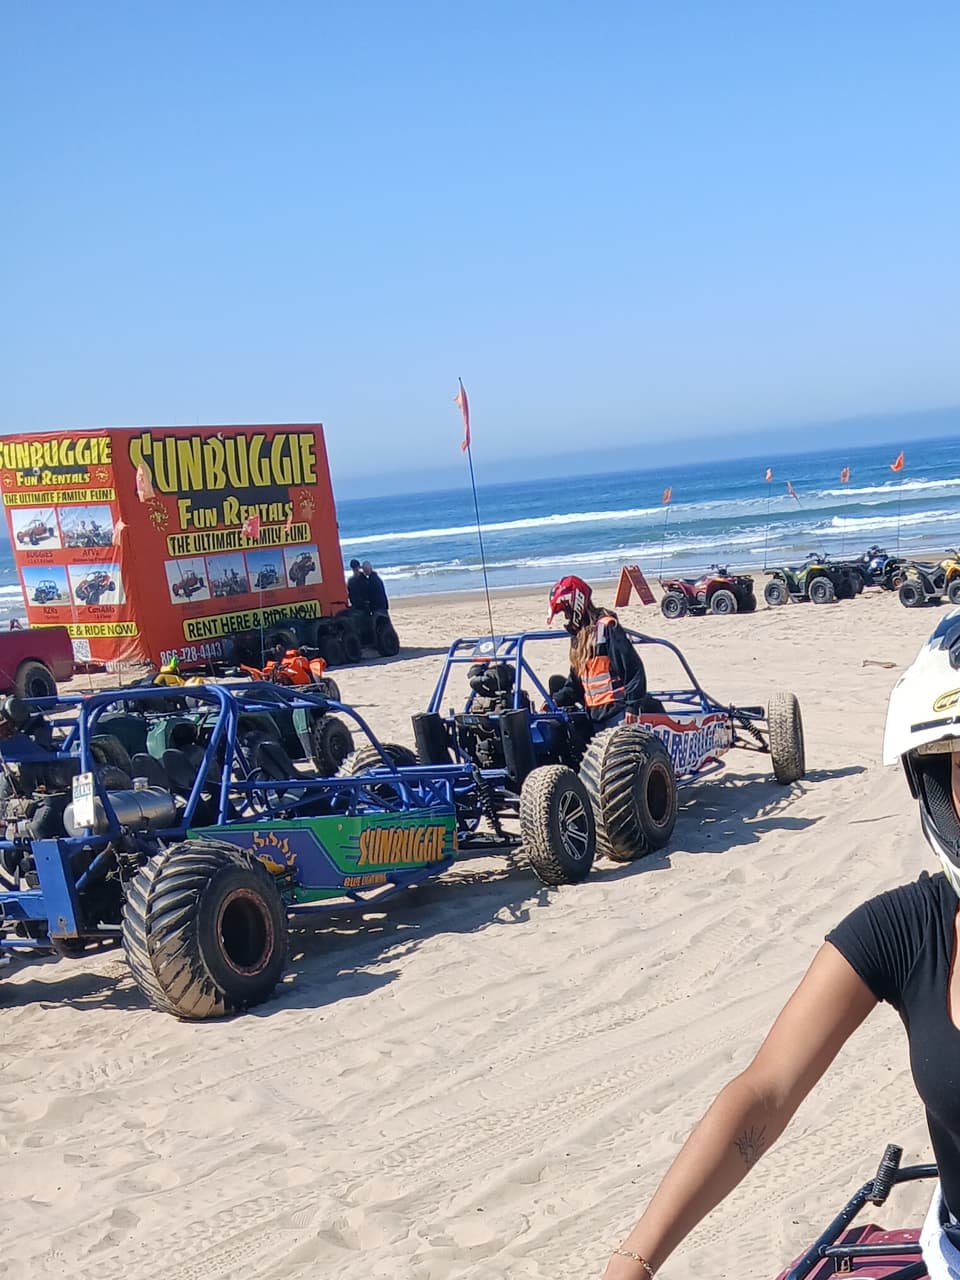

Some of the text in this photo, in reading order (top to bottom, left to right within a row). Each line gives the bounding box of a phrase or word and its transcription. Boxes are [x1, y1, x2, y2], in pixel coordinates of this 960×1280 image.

[0, 437, 112, 469] UNBUGGIE
[129, 432, 317, 493] SUNBUGGIE
[16, 469, 91, 486] FUN RENTALS
[5, 487, 113, 504] THE ULTIMATE FAMILY FUN!
[177, 495, 293, 529] FUN RENTALS
[170, 535, 192, 551] THE
[194, 529, 243, 549] ULTIMATE
[76, 625, 83, 636] &
[85, 624, 106, 636] RIDE
[108, 623, 135, 635] NOW
[187, 620, 222, 639] RENT
[222, 612, 251, 633] HERE
[253, 613, 261, 627] &
[358, 826, 446, 866] SUNBUGGIE
